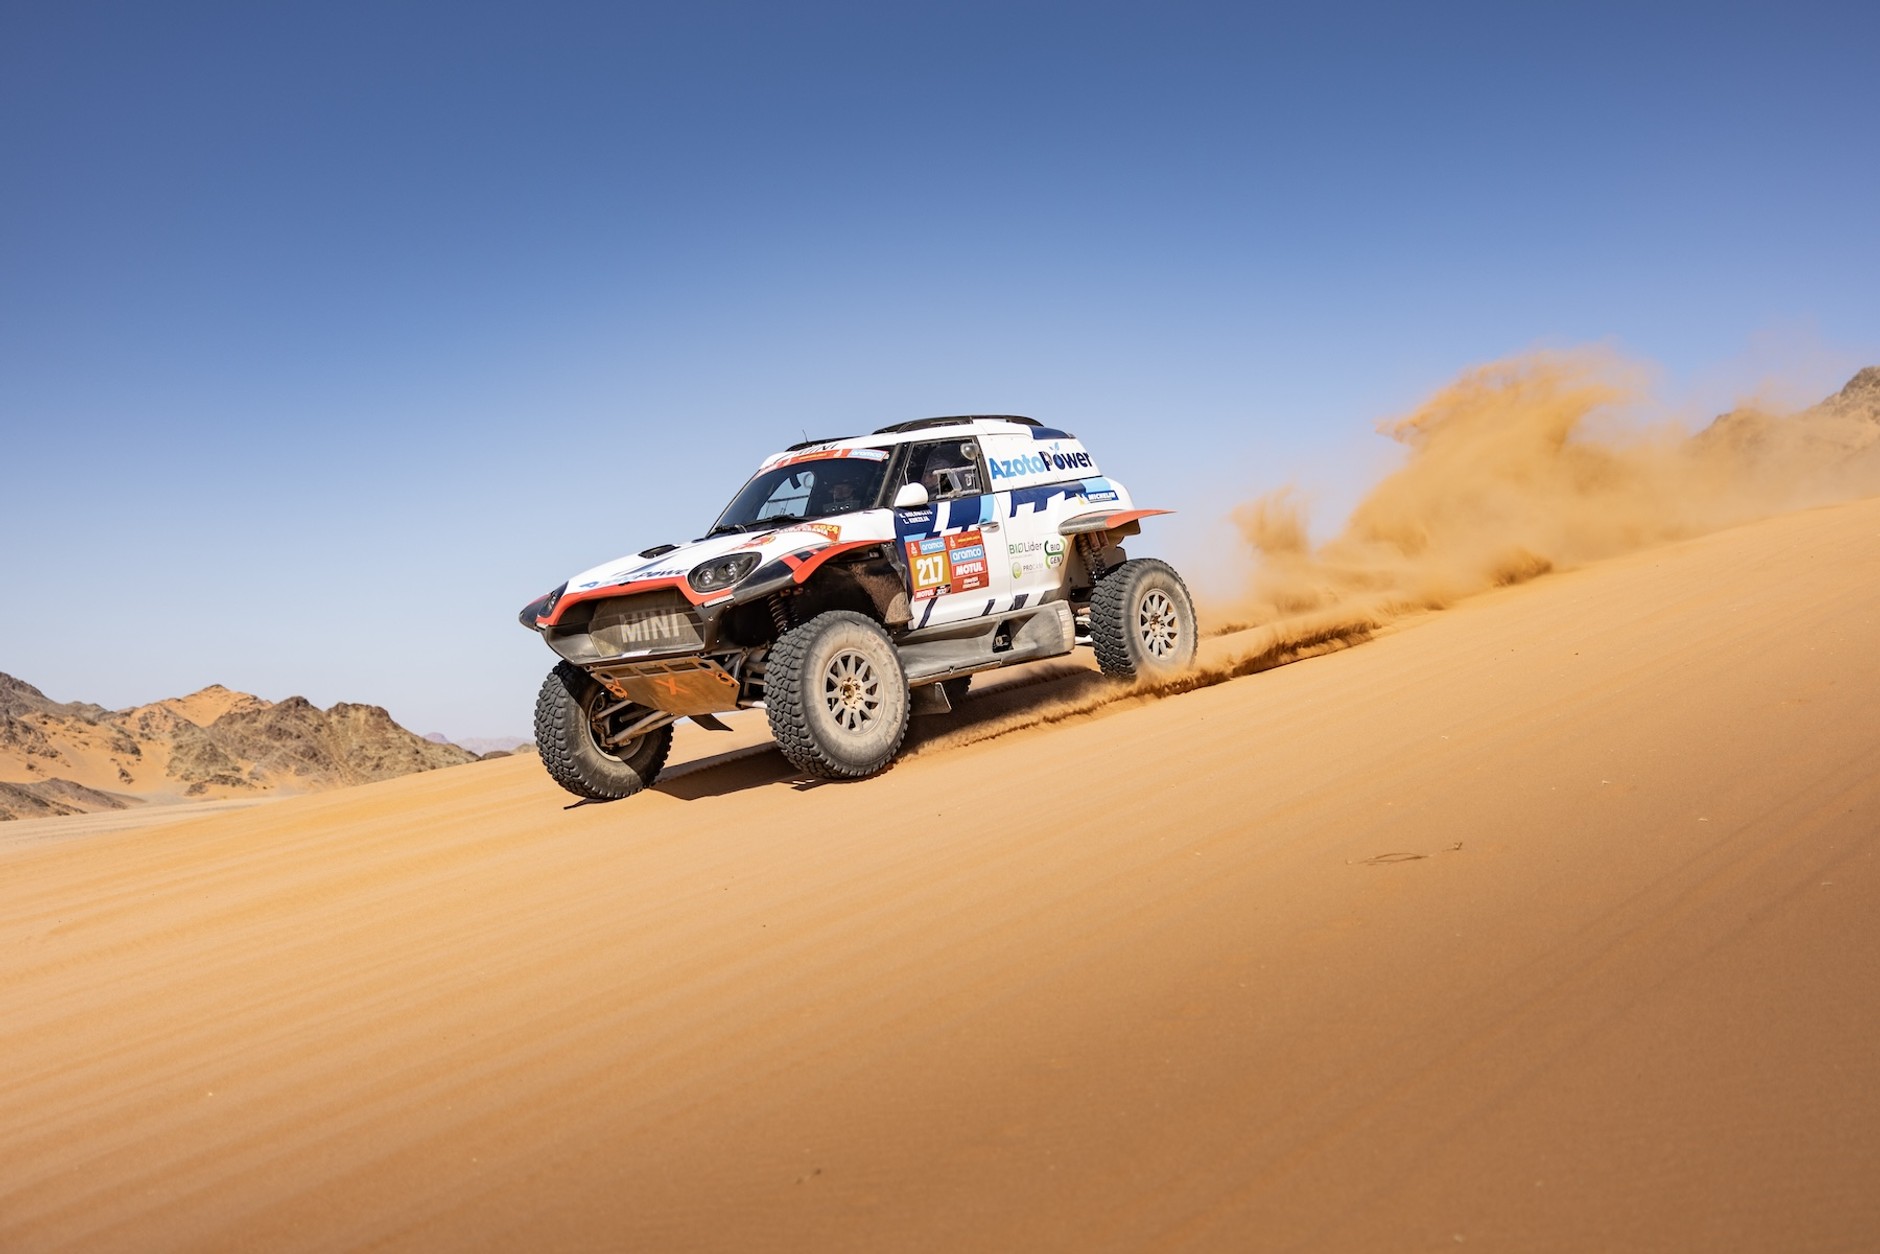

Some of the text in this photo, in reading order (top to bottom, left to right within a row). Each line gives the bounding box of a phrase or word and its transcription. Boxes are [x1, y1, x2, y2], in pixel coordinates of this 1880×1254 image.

[988, 450, 1093, 480] AzotoPower
[921, 541, 944, 551] aramco
[1049, 543, 1061, 551] BIO
[952, 548, 982, 561] aramco
[916, 555, 944, 586] 217
[956, 562, 983, 576] MOTUL
[915, 589, 935, 599] MOTUL
[619, 608, 680, 643] MINI
